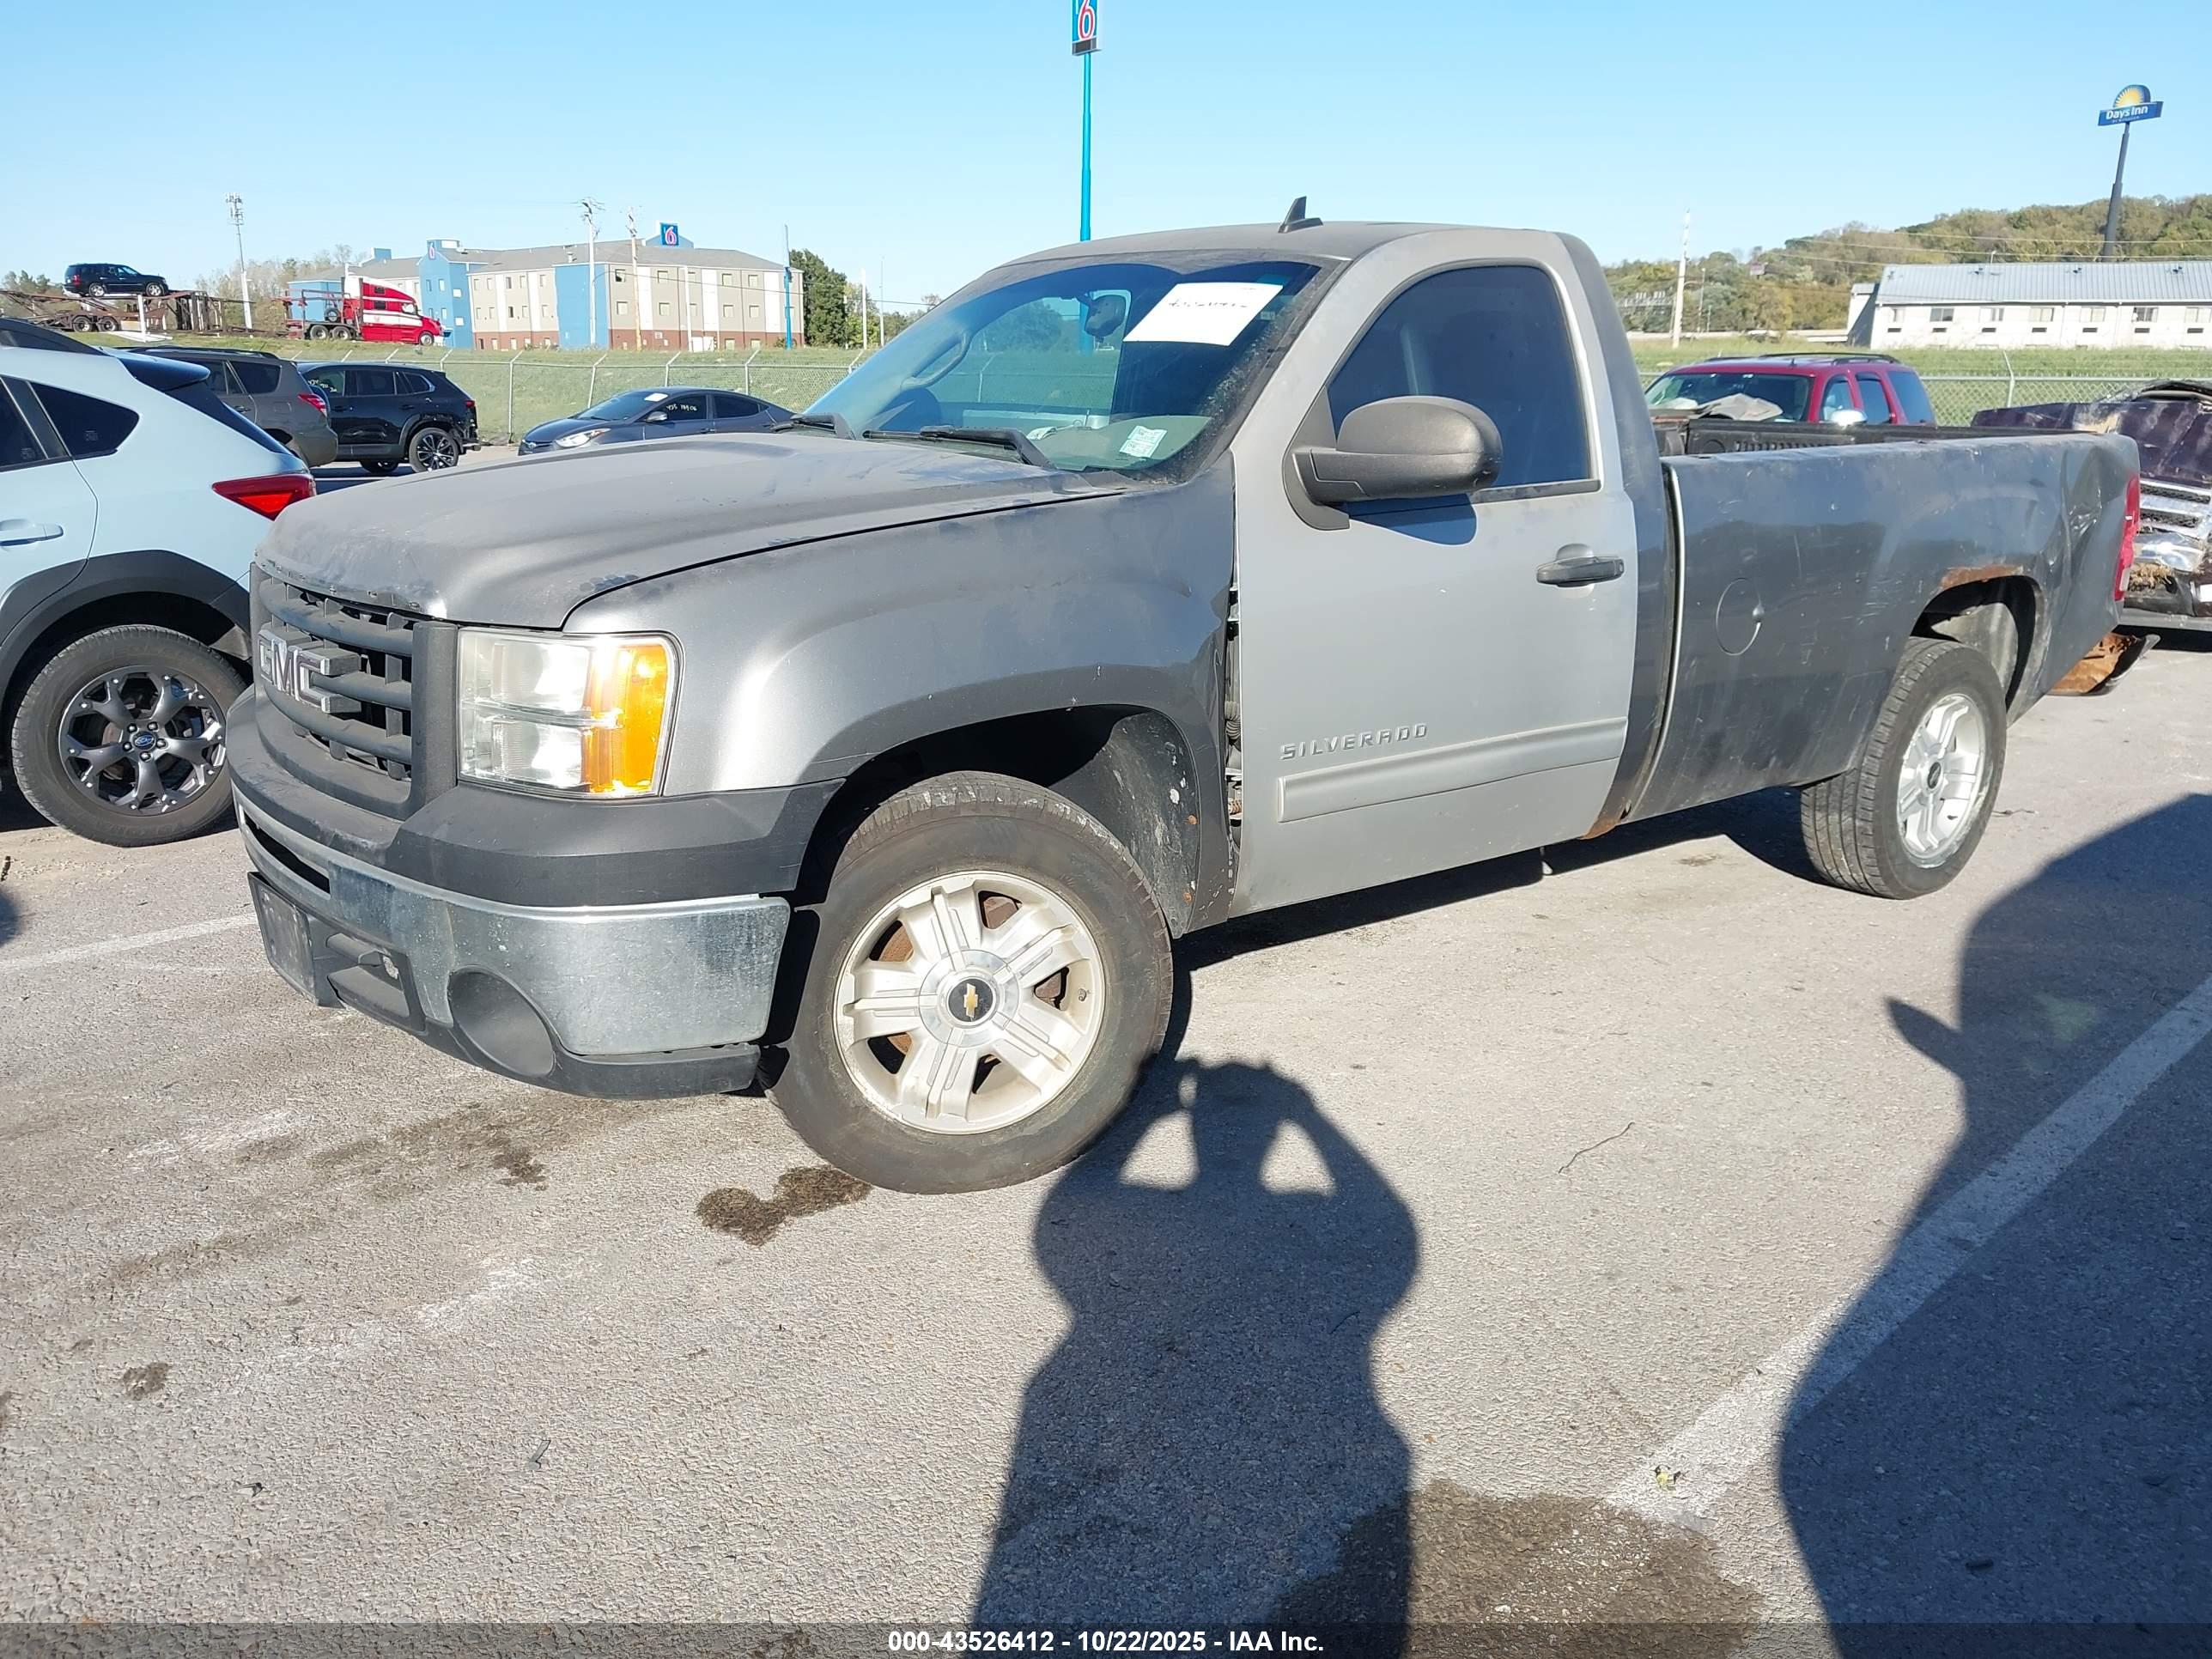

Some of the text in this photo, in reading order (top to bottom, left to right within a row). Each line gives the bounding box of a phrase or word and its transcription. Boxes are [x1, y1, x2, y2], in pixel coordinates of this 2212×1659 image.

[1078, 0, 1096, 40] 6
[2106, 108, 2130, 120] Days
[2130, 106, 2148, 116] Inn
[665, 226, 677, 246] 6
[258, 629, 331, 714] GMC
[1279, 723, 1427, 760] SILVERADO
